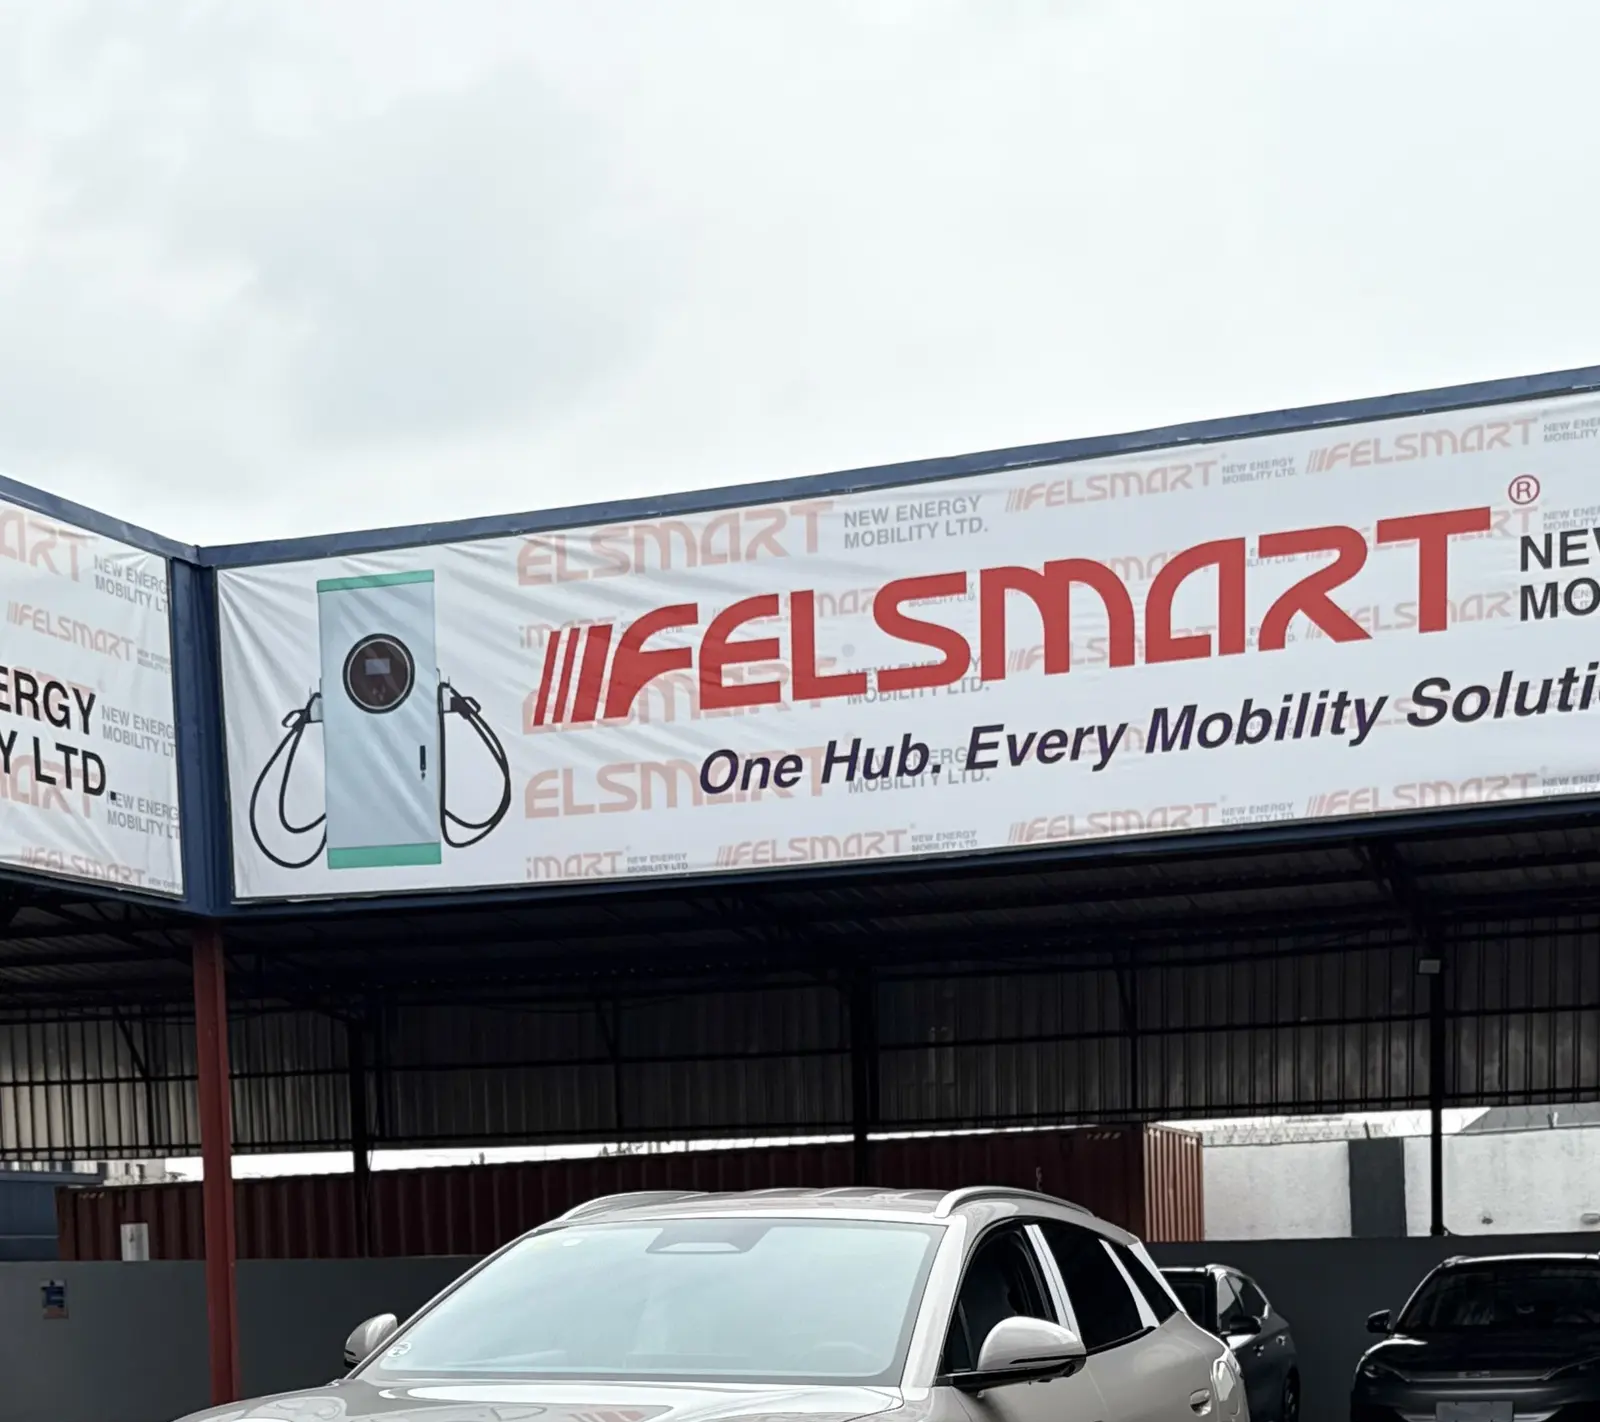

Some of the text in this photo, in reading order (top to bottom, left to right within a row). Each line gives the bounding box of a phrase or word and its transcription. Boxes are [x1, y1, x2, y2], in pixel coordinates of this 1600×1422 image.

[1222, 457, 1295, 475] NEW ENERGY
[1222, 470, 1272, 485] MOBILITY
[843, 495, 983, 528] NEW ENERGY
[843, 515, 990, 550] MOBILITY LTD.
[1520, 526, 1600, 572] NE
[94, 554, 122, 578] NEW
[95, 574, 152, 608] MOBILITY
[603, 506, 1492, 720] FELSMART
[102, 704, 130, 727] NEW
[700, 748, 803, 795] One
[821, 733, 942, 784] Hub.
[965, 722, 1129, 772] Every
[1145, 689, 1389, 753] Mobility
[1406, 661, 1600, 728] Soluti
[102, 726, 160, 751] MOBILITY
[33, 736, 117, 801] LTD.
[107, 809, 164, 837] MOBILITY
[1221, 801, 1295, 817] NEW ENERGY
[911, 830, 978, 843] NEW ENERGY
